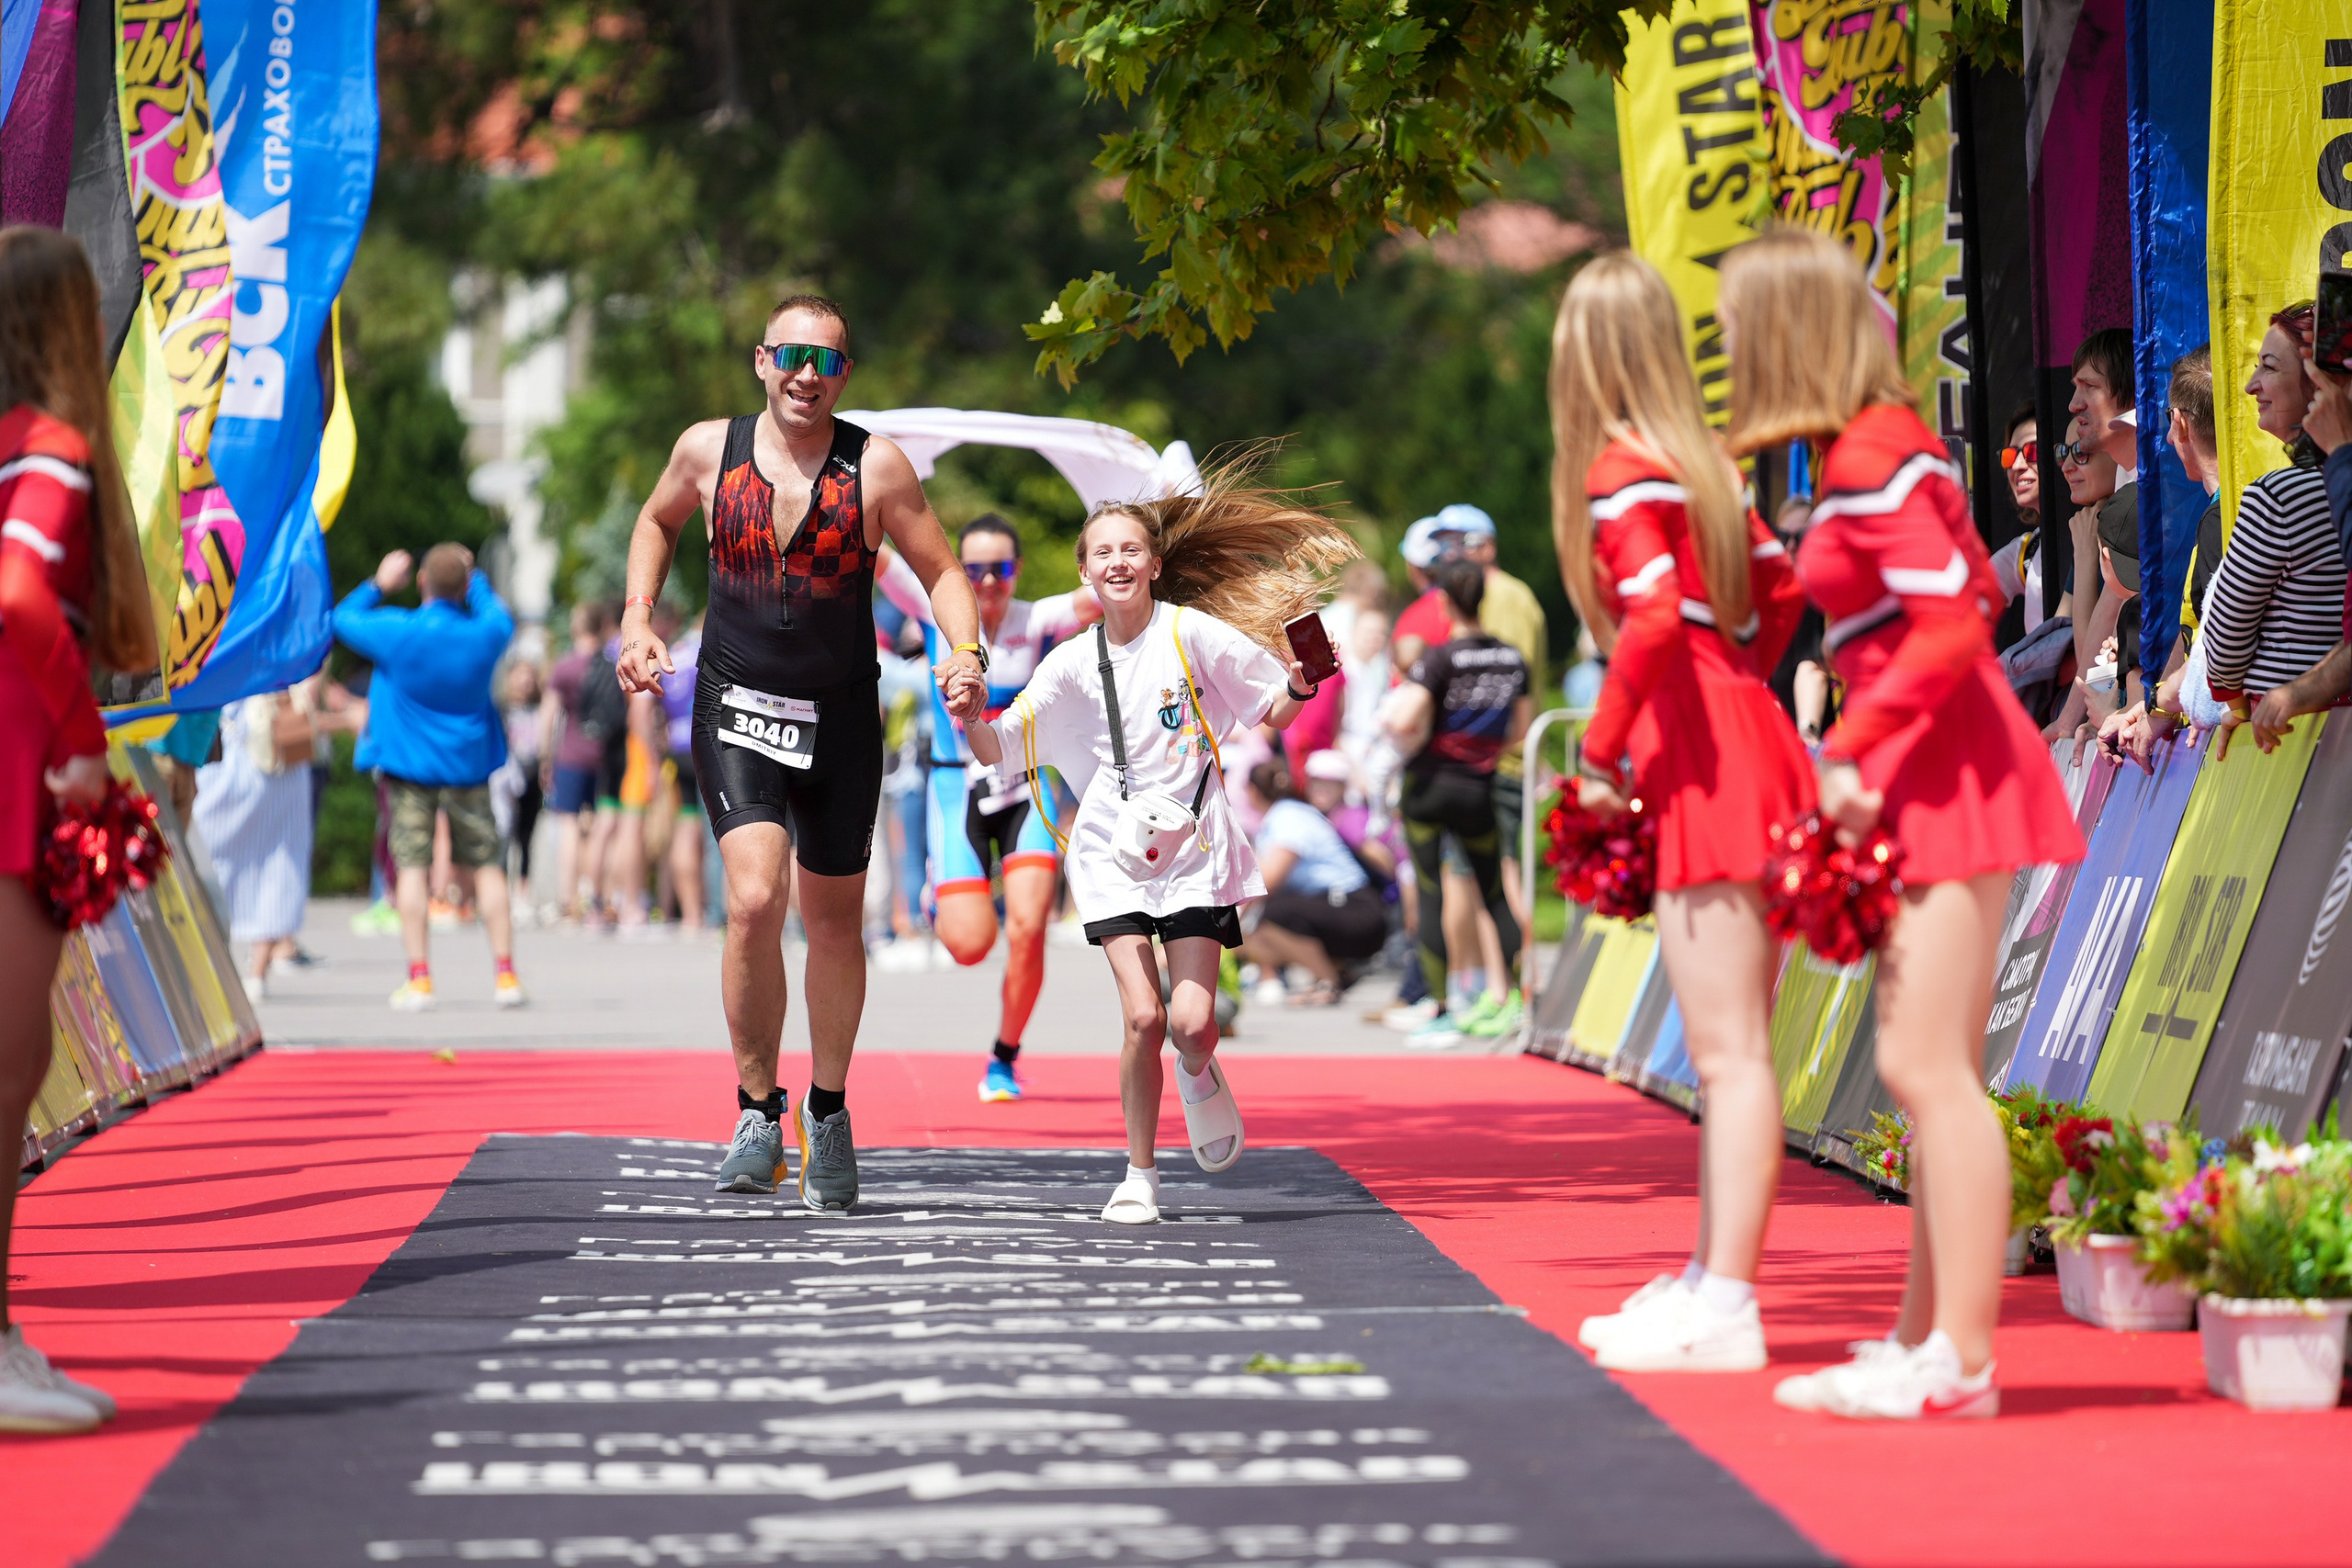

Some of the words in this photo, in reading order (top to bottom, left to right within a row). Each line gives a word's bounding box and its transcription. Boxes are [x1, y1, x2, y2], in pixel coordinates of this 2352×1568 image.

[1672, 13, 1757, 212] STAR
[219, 200, 290, 421] ВСК
[264, 0, 295, 195] СТРАХОВО
[756, 696, 768, 705] IRON
[772, 701, 786, 709] STAR
[733, 712, 800, 750] 3040
[752, 740, 777, 756] DMITRIY
[2186, 874, 2247, 993] STAR
[2038, 875, 2143, 1065] AVA
[980, 1212, 1243, 1224] STR
[989, 1253, 1276, 1268] STAR
